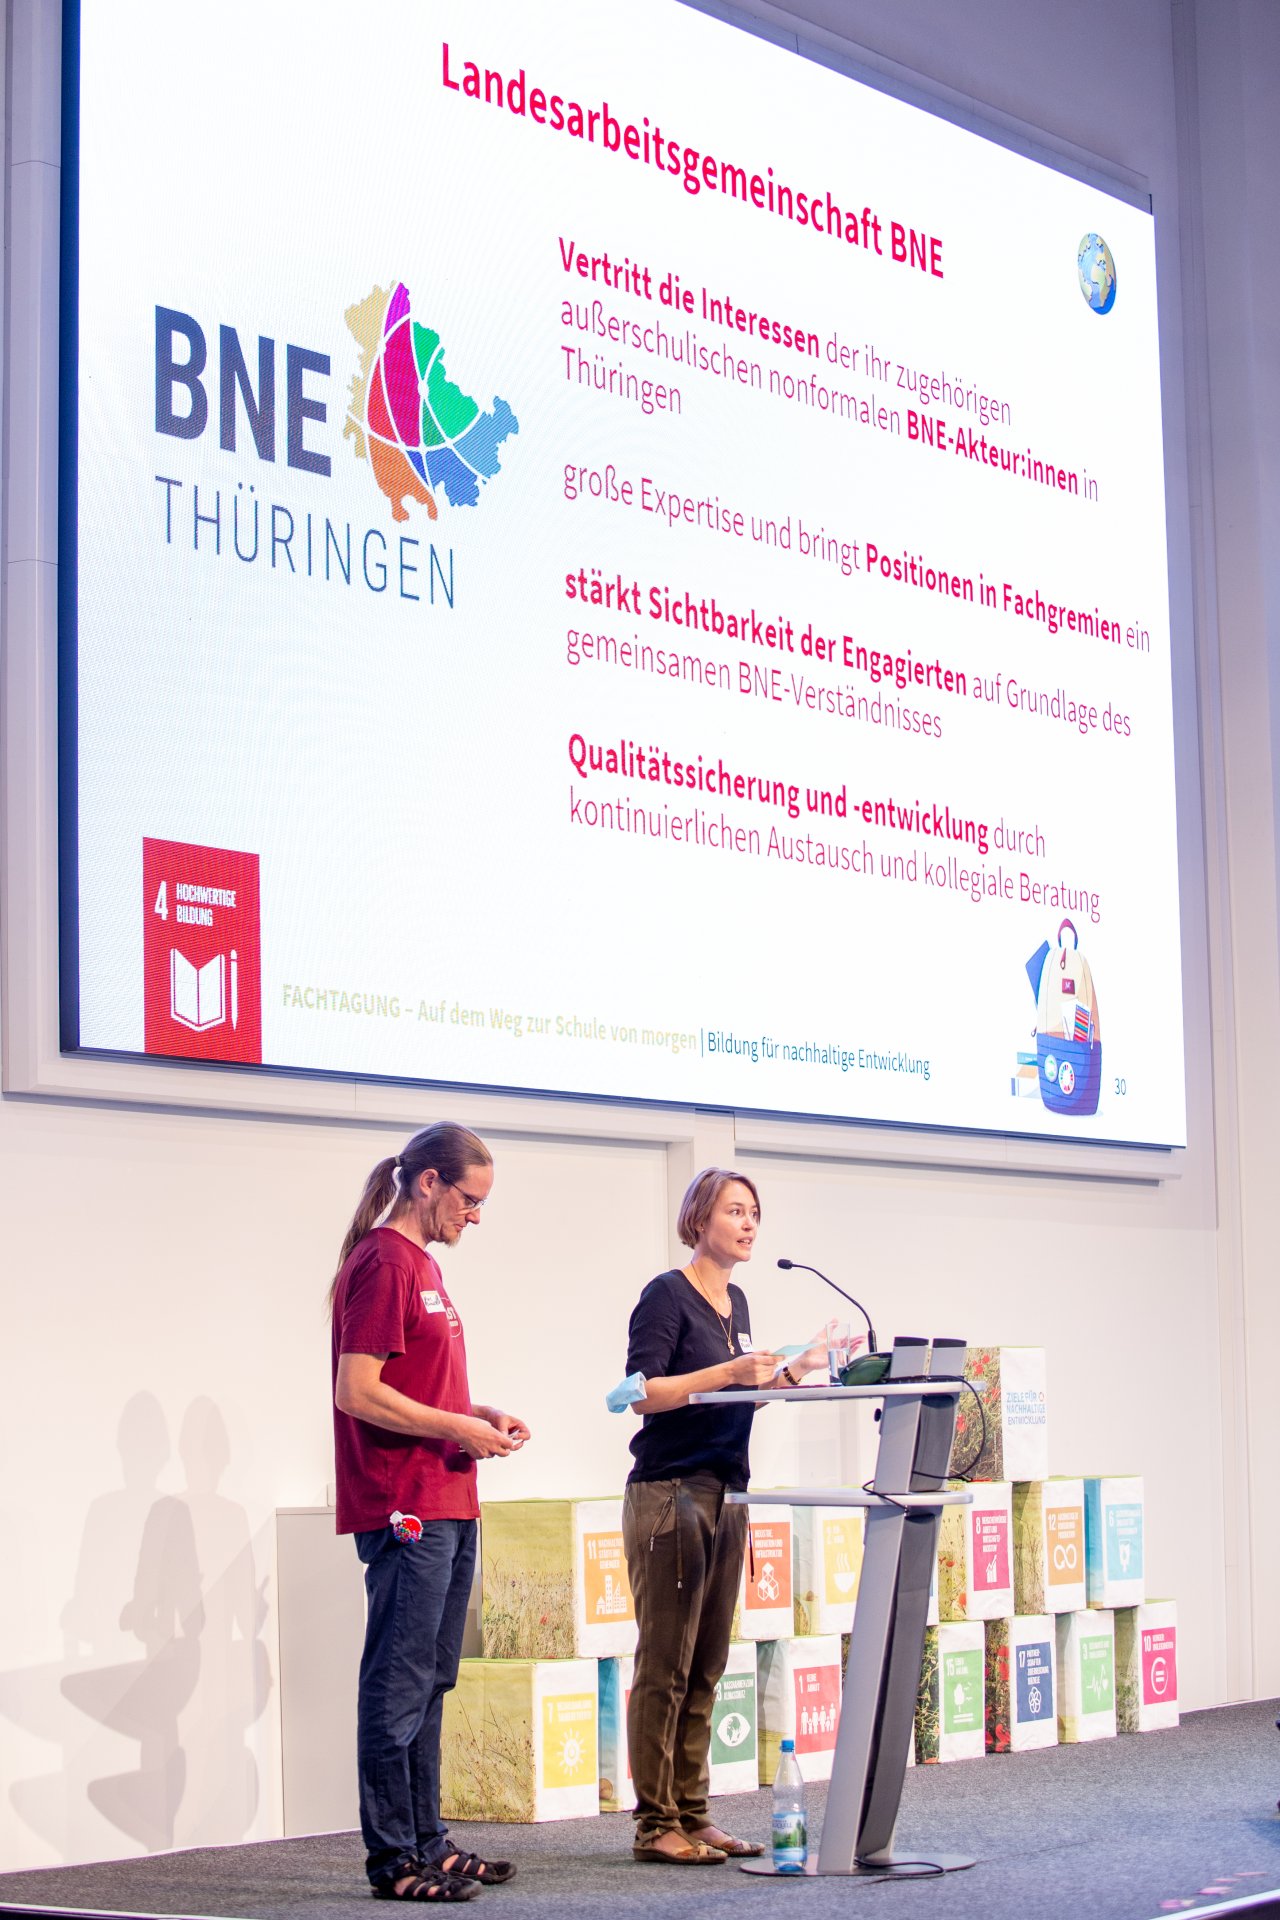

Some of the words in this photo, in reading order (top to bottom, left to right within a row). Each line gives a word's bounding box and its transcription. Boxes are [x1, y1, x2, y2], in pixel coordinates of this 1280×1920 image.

[442, 42, 883, 256] Landesarbeitsgemeinschaft
[891, 221, 944, 279] BNE
[558, 237, 652, 300] Vertritt
[659, 272, 695, 314] die
[702, 287, 820, 358] Interessen
[826, 332, 859, 371] der
[865, 344, 891, 382] ihr
[896, 365, 1010, 426] zugehörigen
[561, 345, 681, 415] Thüringen
[155, 304, 331, 477] BNE
[560, 299, 761, 389] außerschulischen
[770, 369, 900, 435] nonformalen
[907, 409, 1078, 495] BNE-Akteur:innen
[1084, 469, 1098, 502] in
[155, 475, 454, 609] THÜRINGEN
[562, 464, 633, 505] große
[641, 477, 744, 537] Expertise
[751, 516, 791, 549] und
[799, 519, 860, 576] bringt
[866, 543, 973, 602] Positionen
[979, 573, 996, 609] in
[1003, 583, 1121, 644] Fachgremien
[1126, 622, 1150, 653] ein
[565, 568, 642, 616] stärkt
[649, 585, 794, 653] Sichtbarkeit
[800, 623, 836, 663] der
[843, 635, 967, 696] Engagierten
[973, 673, 1002, 704] auf
[1007, 679, 1097, 734] Grundlage
[1103, 702, 1131, 736] des
[567, 629, 730, 690] gemeinsamen
[739, 661, 942, 738] BNE-Verständnisses
[568, 733, 800, 819] Qualitätssicherung
[806, 784, 847, 818] und
[853, 797, 989, 855] -entwicklung
[994, 817, 1045, 858] durch
[155, 881, 168, 920] 4
[176, 883, 236, 908] HOCHWERTIGE
[570, 785, 760, 855] kontinuierlichen
[767, 826, 873, 875] Austausch
[881, 850, 917, 882] und
[924, 852, 1014, 903] kollegiale
[1020, 872, 1100, 923] Beratung
[176, 905, 213, 926] BILDUNG
[283, 984, 400, 1017] FACHTAGUNG
[418, 1000, 446, 1023] Auf
[450, 1002, 484, 1027] dem
[490, 1008, 522, 1037] Weg
[527, 1016, 551, 1033] zur
[556, 1015, 606, 1040] Schule
[611, 1025, 637, 1043] von
[642, 1029, 696, 1054] morgen
[708, 1031, 759, 1063] Bildung
[761, 1036, 779, 1058] für
[783, 1041, 855, 1072] nachhaltige
[858, 1049, 931, 1081] Entwicklung
[1114, 1077, 1127, 1096] 30
[587, 1539, 597, 1559] 11
[976, 1516, 981, 1534] 8
[1048, 1513, 1057, 1531] 12
[798, 1675, 803, 1694] 1
[1019, 1650, 1026, 1668] 17
[1144, 1635, 1152, 1652] 10
